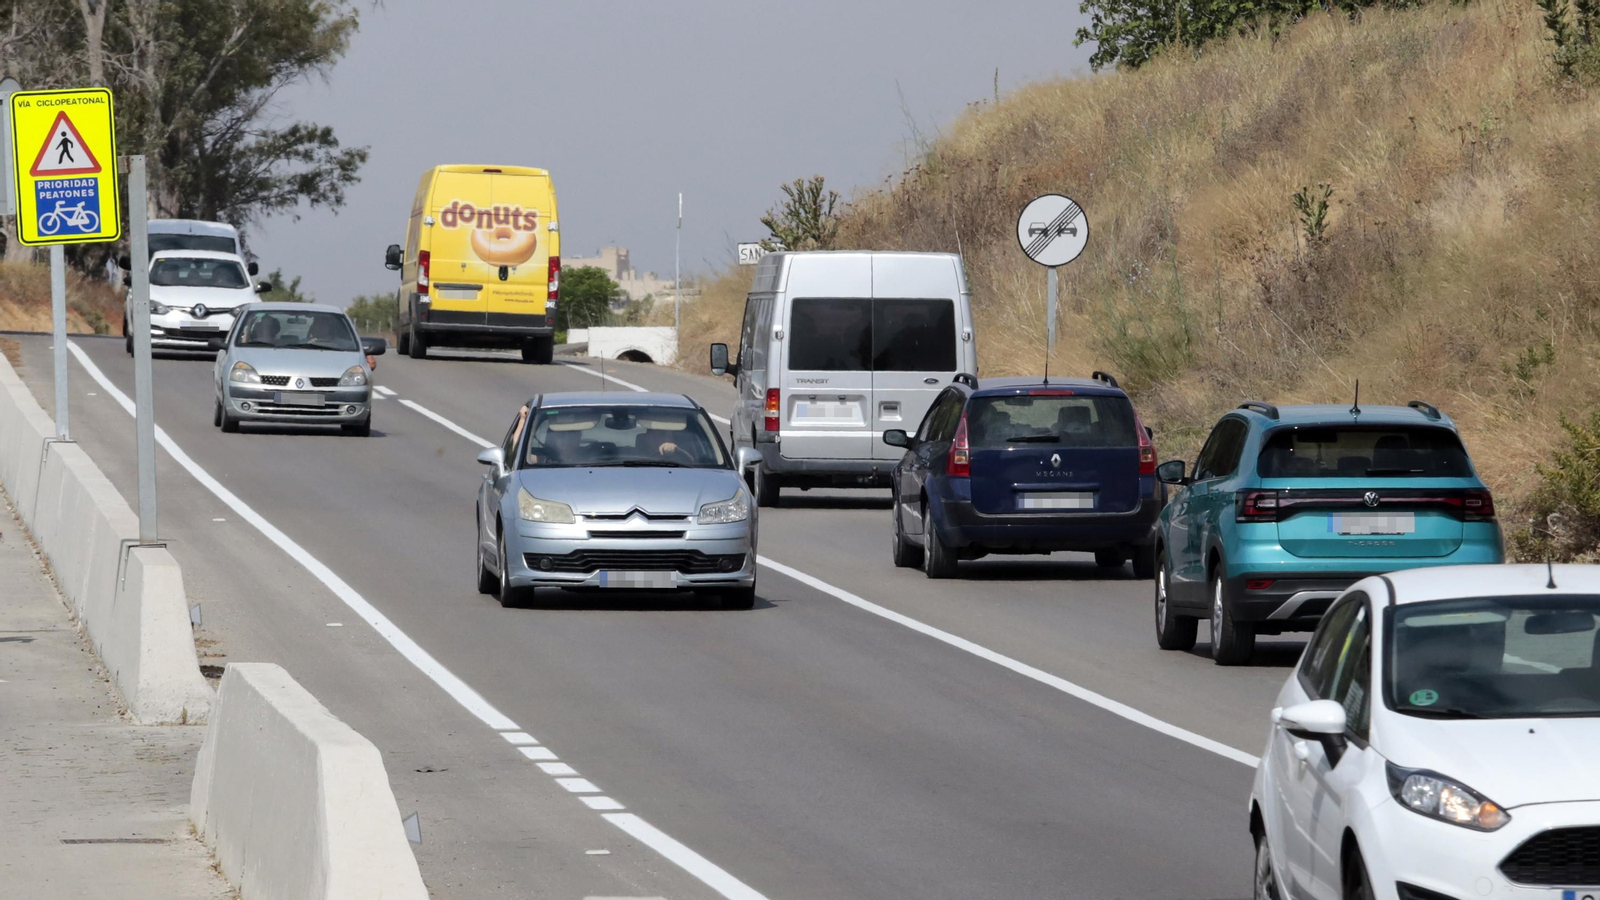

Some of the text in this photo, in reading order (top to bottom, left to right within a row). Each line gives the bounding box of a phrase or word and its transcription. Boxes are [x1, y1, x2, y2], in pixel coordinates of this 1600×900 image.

[18, 97, 105, 108] VÍA CICLOPEATONAL
[37, 179, 95, 189] PRIORIDAD
[39, 189, 95, 199] PEATONES
[440, 201, 538, 231] donuts
